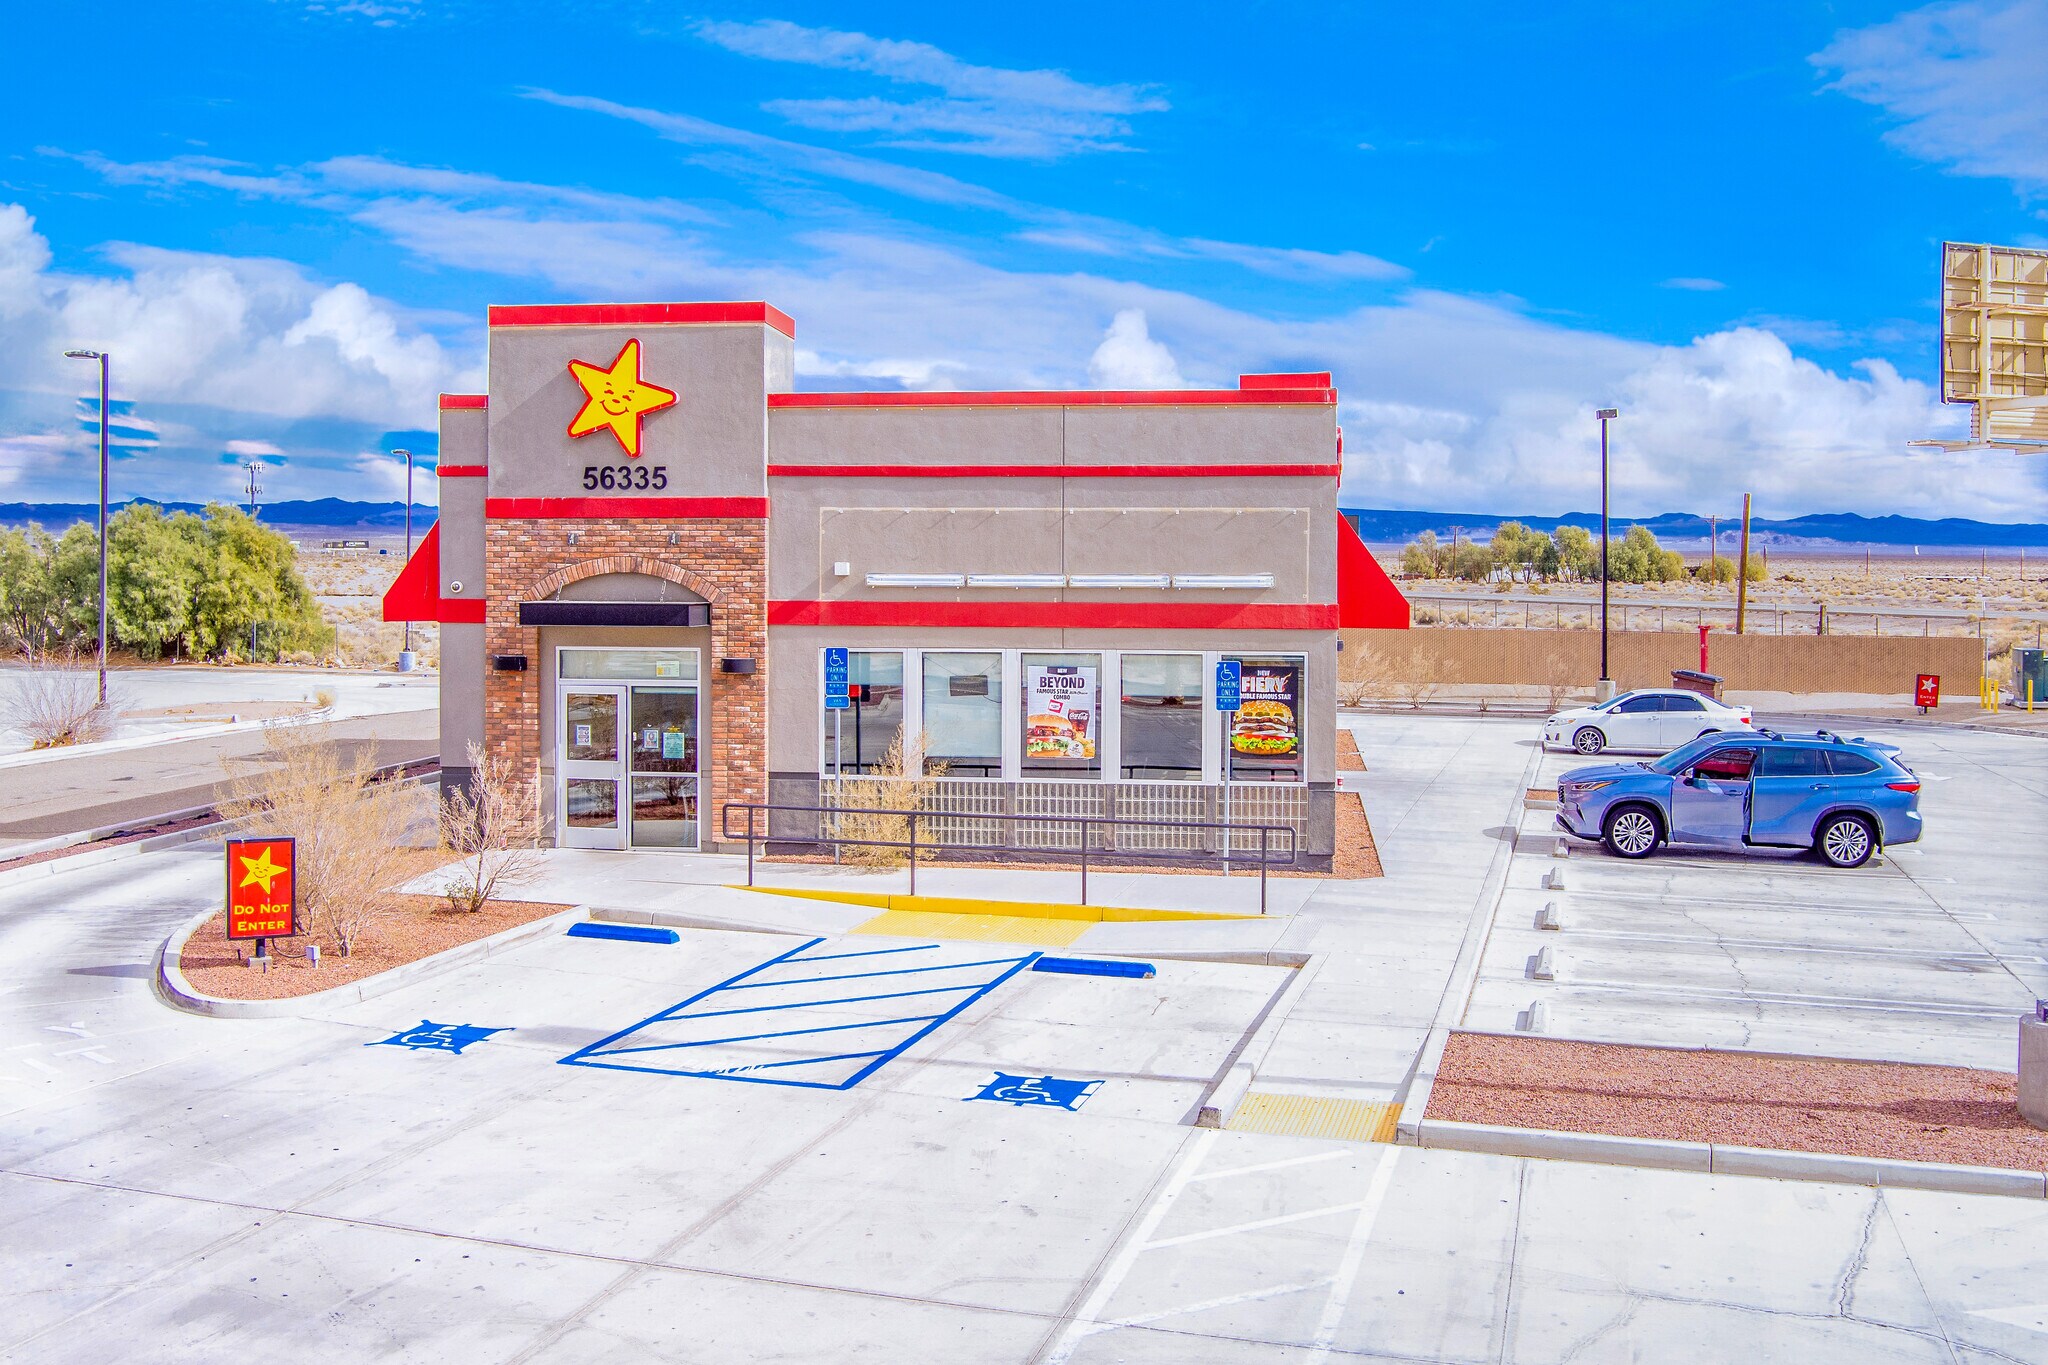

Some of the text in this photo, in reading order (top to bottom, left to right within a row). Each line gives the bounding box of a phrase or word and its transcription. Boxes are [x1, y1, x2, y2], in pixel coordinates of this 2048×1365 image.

[582, 466, 667, 490] 56335
[826, 666, 847, 674] PARKING
[830, 674, 844, 682] ONLY
[1039, 676, 1085, 689] BEYOND
[1217, 681, 1239, 689] PARKING
[1241, 677, 1286, 692] FIERY
[234, 904, 290, 915] DO NOT
[237, 920, 286, 932] ENTER
